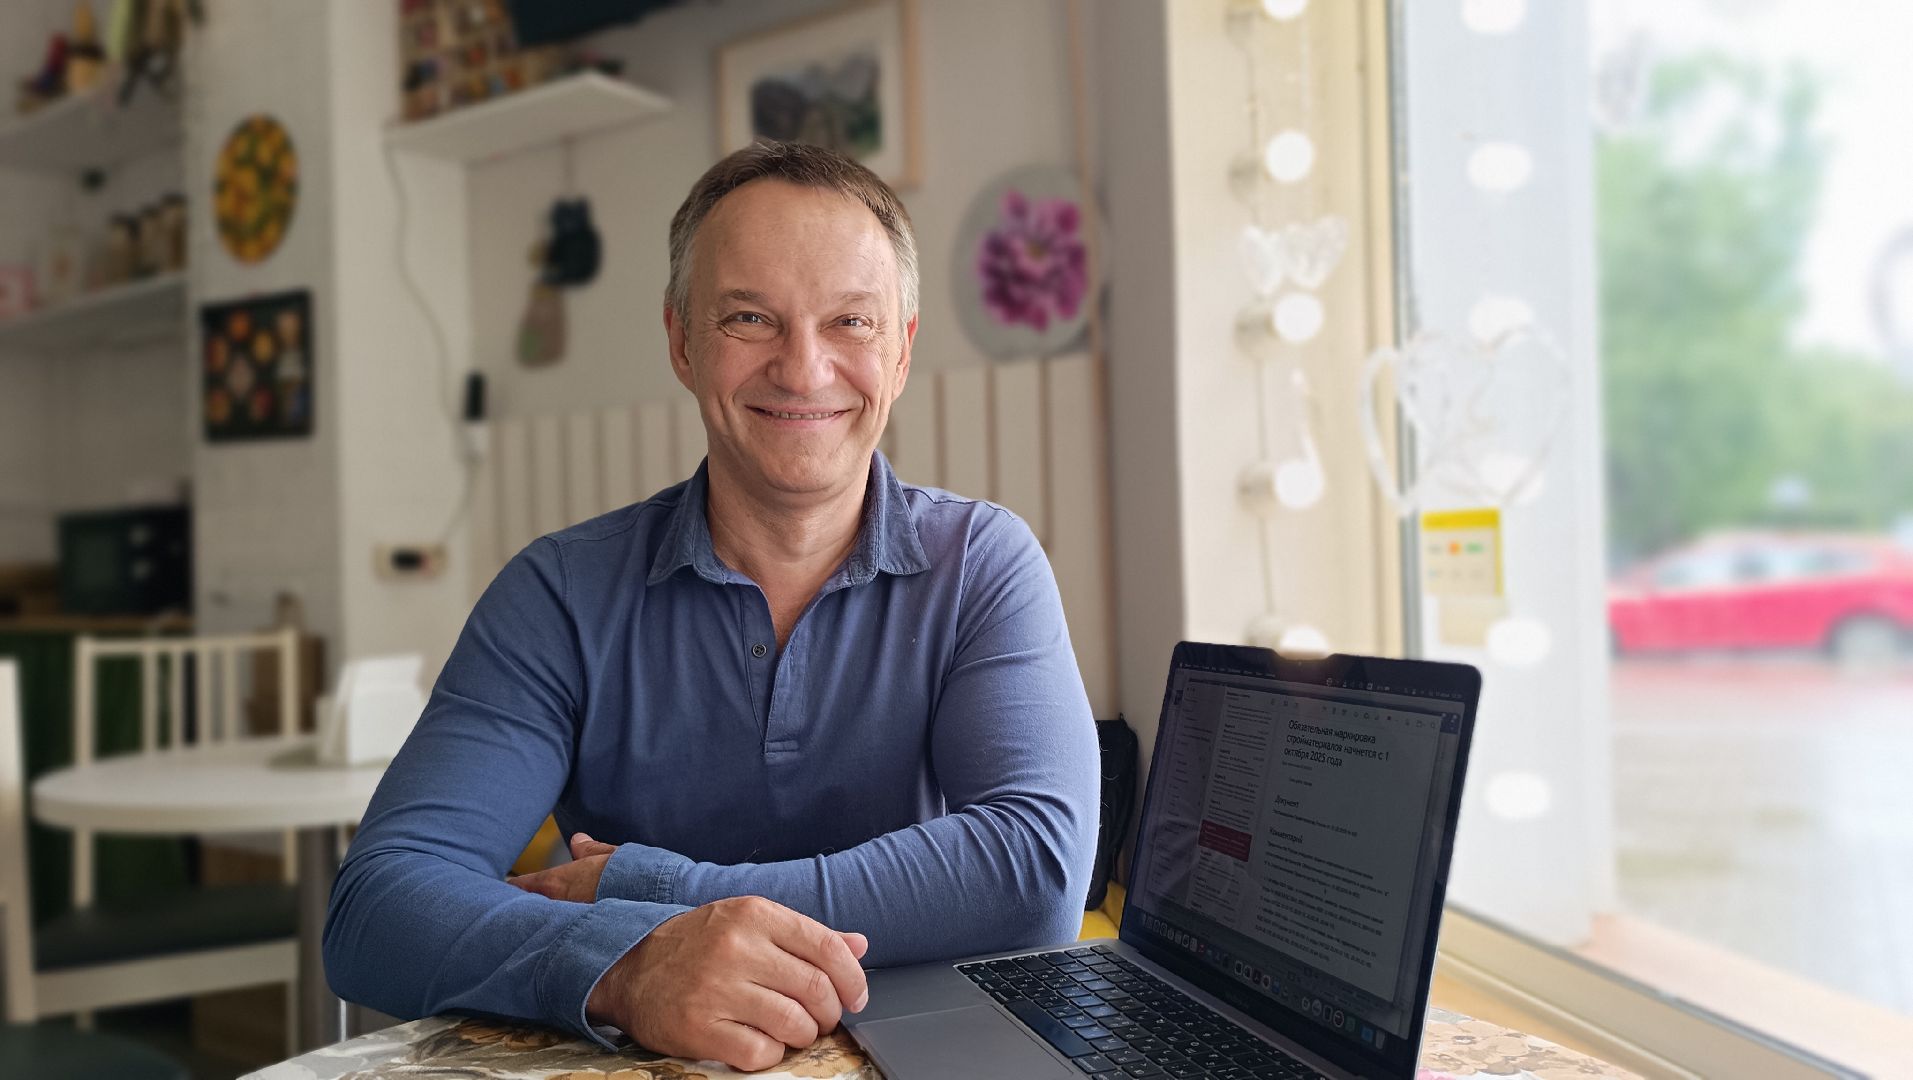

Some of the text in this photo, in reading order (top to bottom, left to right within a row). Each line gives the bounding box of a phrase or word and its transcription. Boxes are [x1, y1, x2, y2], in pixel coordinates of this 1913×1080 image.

[1288, 720, 1376, 744] Обязательная маркировка
[1286, 734, 1342, 752] стройматериалов
[1344, 746, 1377, 759] начнется
[1284, 748, 1309, 760] октября
[1310, 751, 1325, 763] 2025
[1326, 756, 1343, 768] года
[1274, 795, 1299, 808] Документ
[1269, 828, 1303, 844] Комментарий
